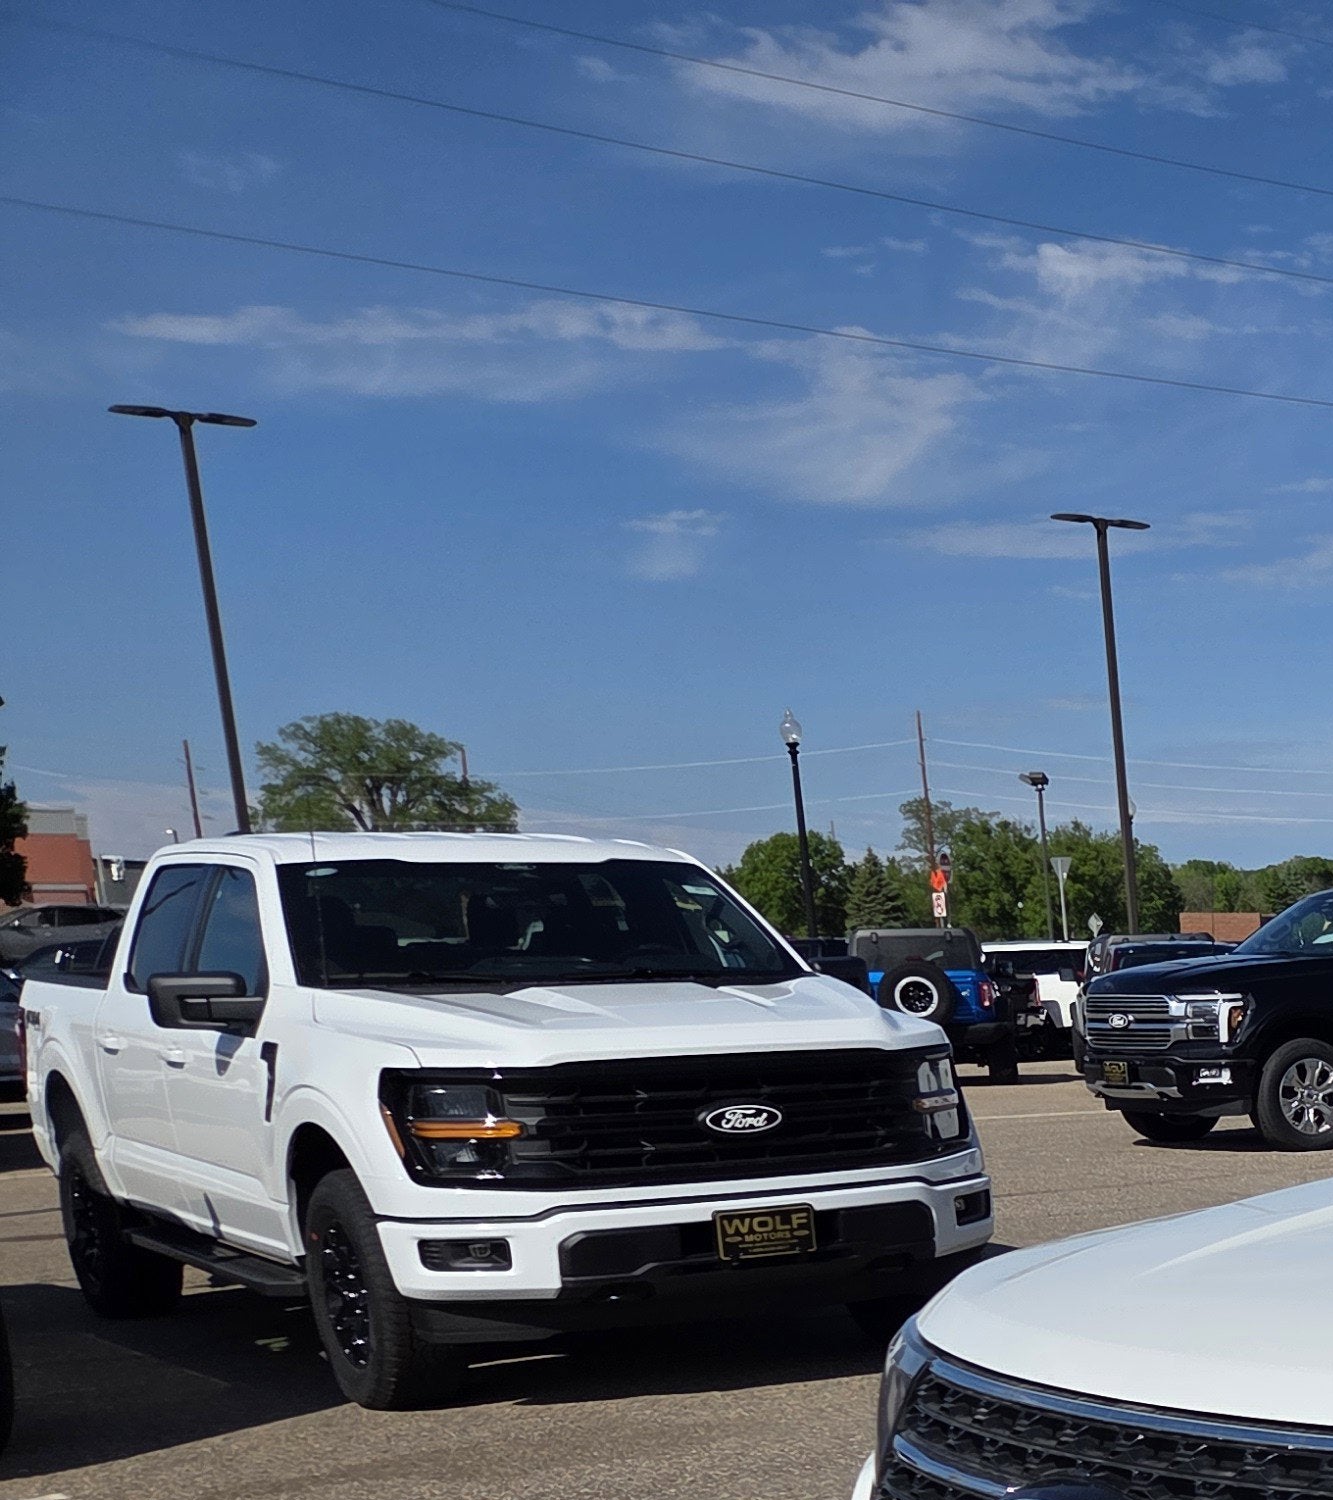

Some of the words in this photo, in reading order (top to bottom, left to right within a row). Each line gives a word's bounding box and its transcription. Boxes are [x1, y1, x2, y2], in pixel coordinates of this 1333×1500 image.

[721, 1109, 768, 1129] Ford
[722, 1212, 809, 1235] WOLF
[744, 1230, 791, 1242] MOTORS
